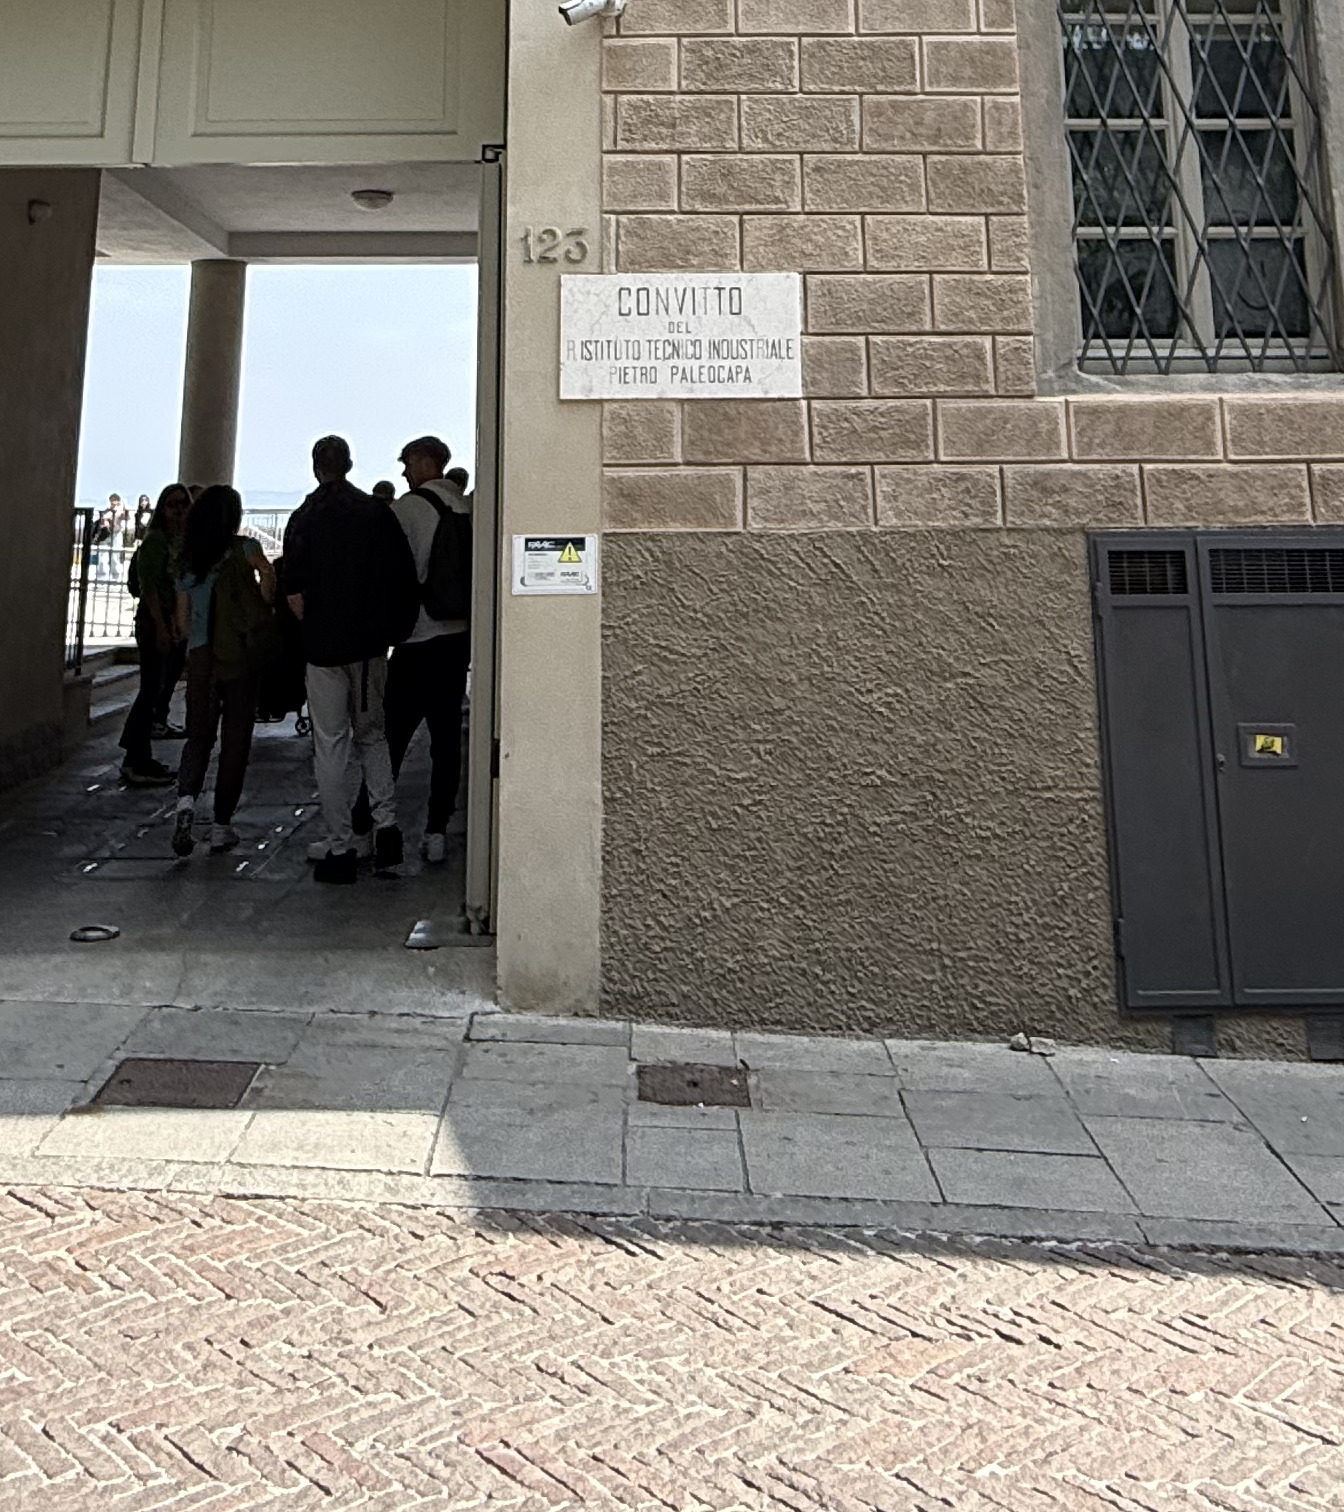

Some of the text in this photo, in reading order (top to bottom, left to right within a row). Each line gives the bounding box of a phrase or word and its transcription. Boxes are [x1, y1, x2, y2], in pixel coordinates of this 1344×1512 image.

[520, 225, 590, 265] 123
[618, 286, 743, 317] CONVITTO
[668, 321, 692, 334] DEL
[580, 339, 642, 361] ISTITUTO
[647, 339, 702, 361] TECNICO
[708, 338, 795, 361] INDUSTRIALE
[609, 365, 753, 384] PIETRO PALEOCAPA
